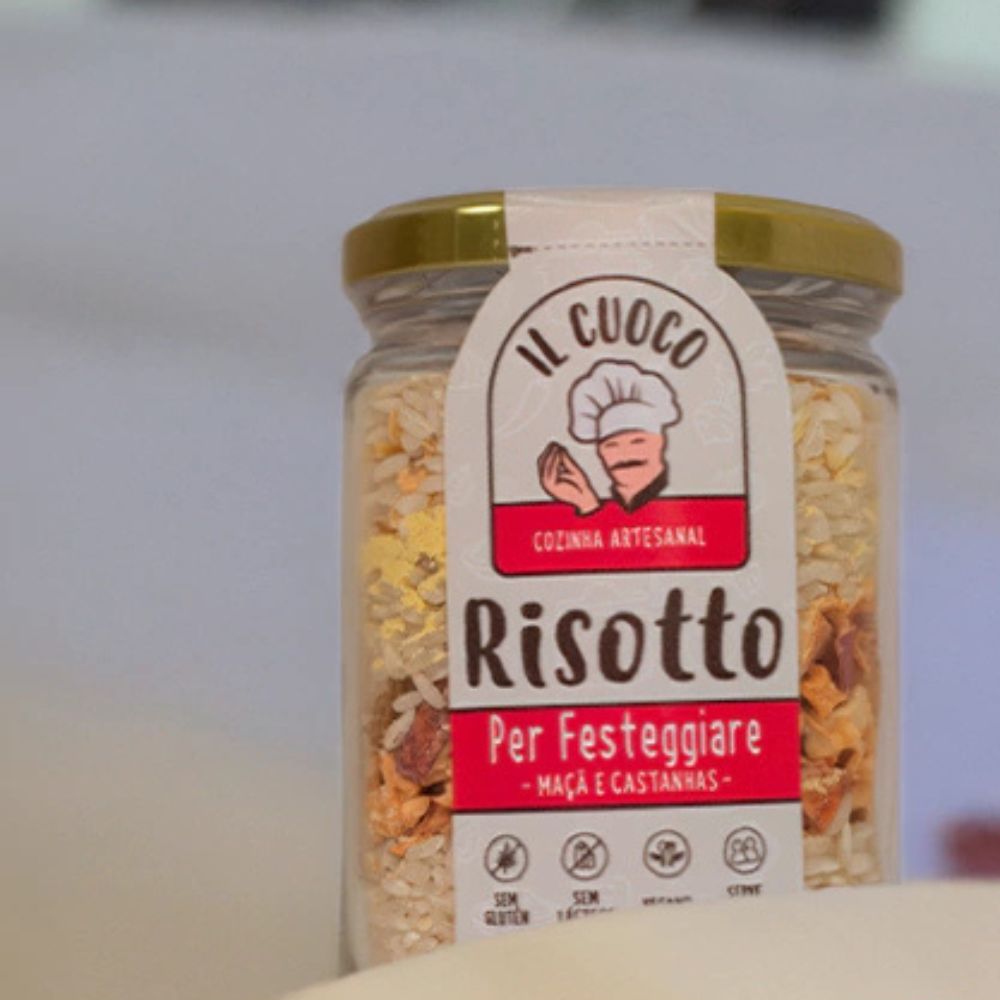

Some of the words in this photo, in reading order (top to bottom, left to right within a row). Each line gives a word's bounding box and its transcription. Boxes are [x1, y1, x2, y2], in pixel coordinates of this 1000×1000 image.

[515, 328, 570, 377] IL
[568, 296, 709, 369] CUOCO
[532, 529, 603, 552] COZINHA
[610, 525, 706, 548] ARTESANAL
[464, 586, 783, 688] Risotto
[488, 713, 543, 765] Per
[558, 708, 762, 767] Festeggiare
[537, 769, 588, 800] MAÇÃ
[595, 774, 604, 796] E
[610, 768, 718, 795] CASTANHAS
[493, 891, 519, 908] SEM
[571, 889, 600, 905] SEM
